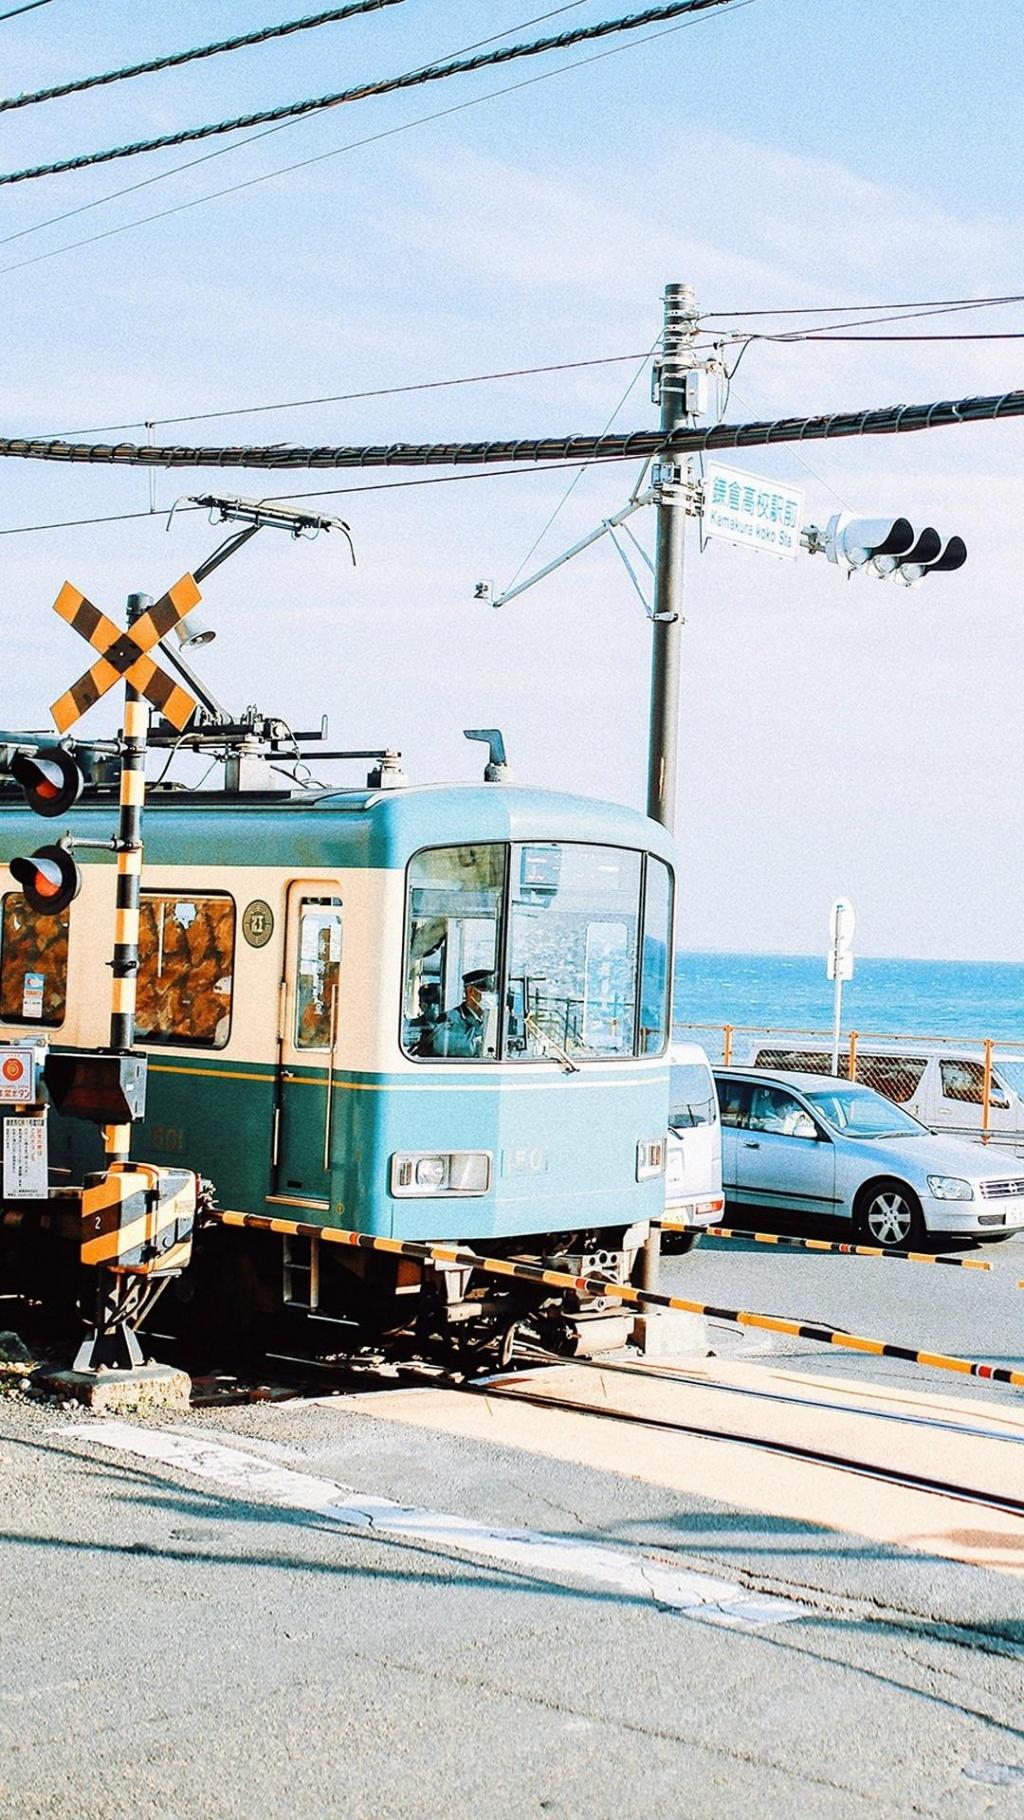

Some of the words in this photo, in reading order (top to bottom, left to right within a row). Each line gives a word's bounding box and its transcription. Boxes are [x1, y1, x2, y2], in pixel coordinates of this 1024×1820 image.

[712, 476, 798, 528] 鎌倉高校駅前
[710, 510, 753, 536] Kamakura
[95, 1216, 101, 1230] 2
